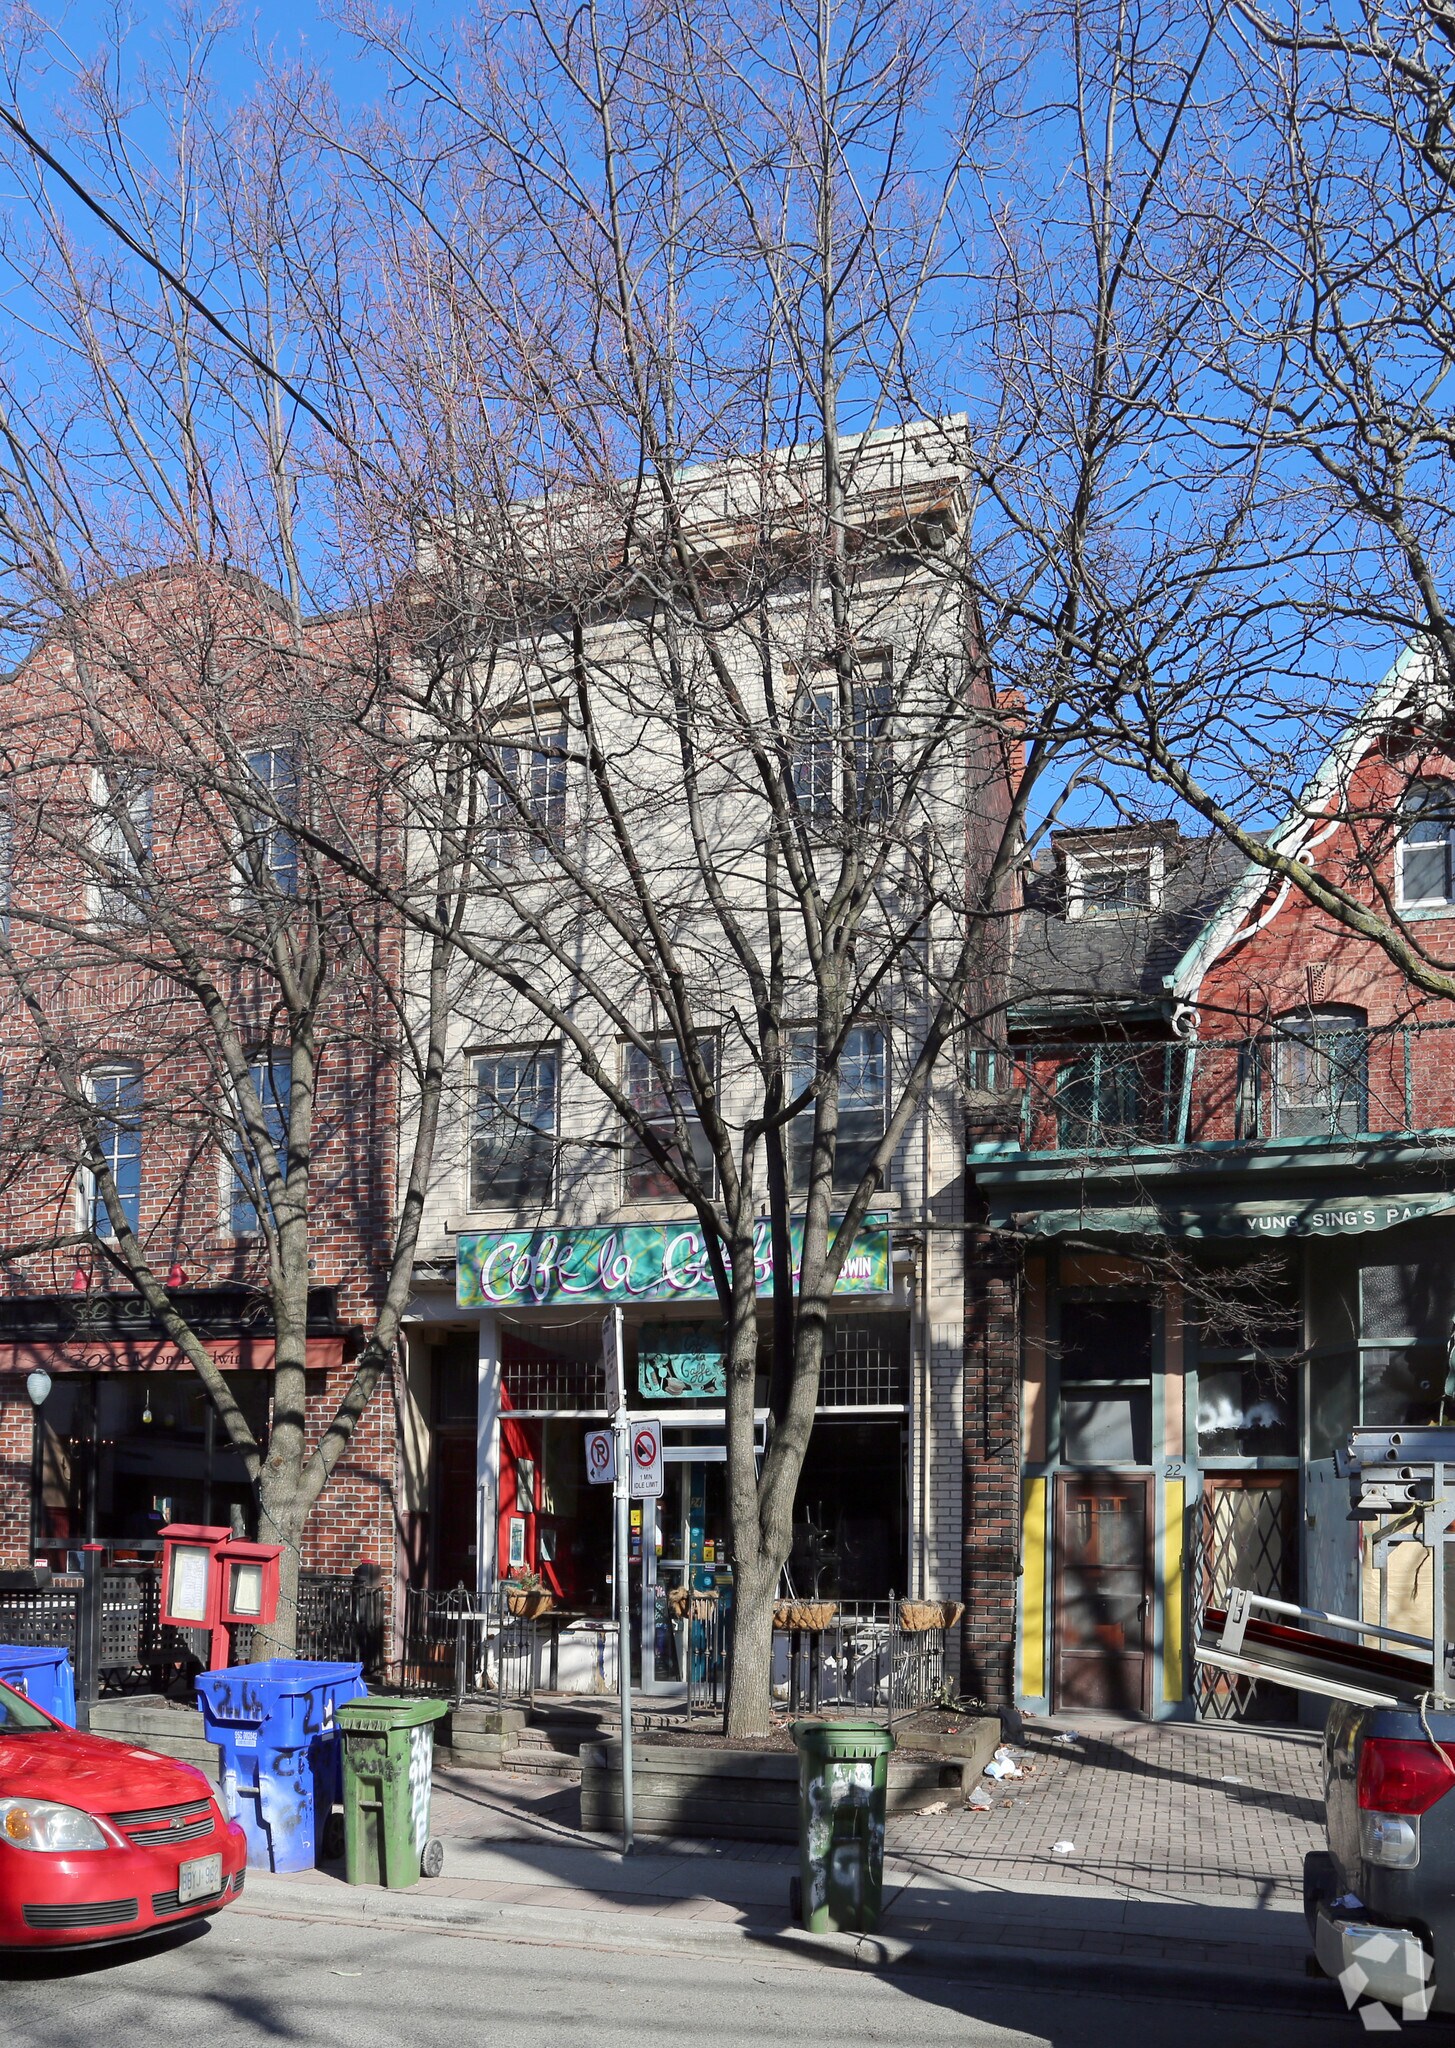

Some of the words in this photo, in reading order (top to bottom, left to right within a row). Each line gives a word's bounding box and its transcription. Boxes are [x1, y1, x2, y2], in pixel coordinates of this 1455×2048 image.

[1247, 1215, 1299, 1230] YUNG
[1312, 1210, 1375, 1227] SING'S
[481, 1233, 581, 1301] Café
[599, 1232, 640, 1294] la
[154, 1356, 174, 1366] on
[180, 1350, 241, 1366] Bdwin
[681, 1357, 713, 1384] Gaffe
[1165, 1464, 1182, 1476] 22
[634, 1481, 645, 1489] IDLE
